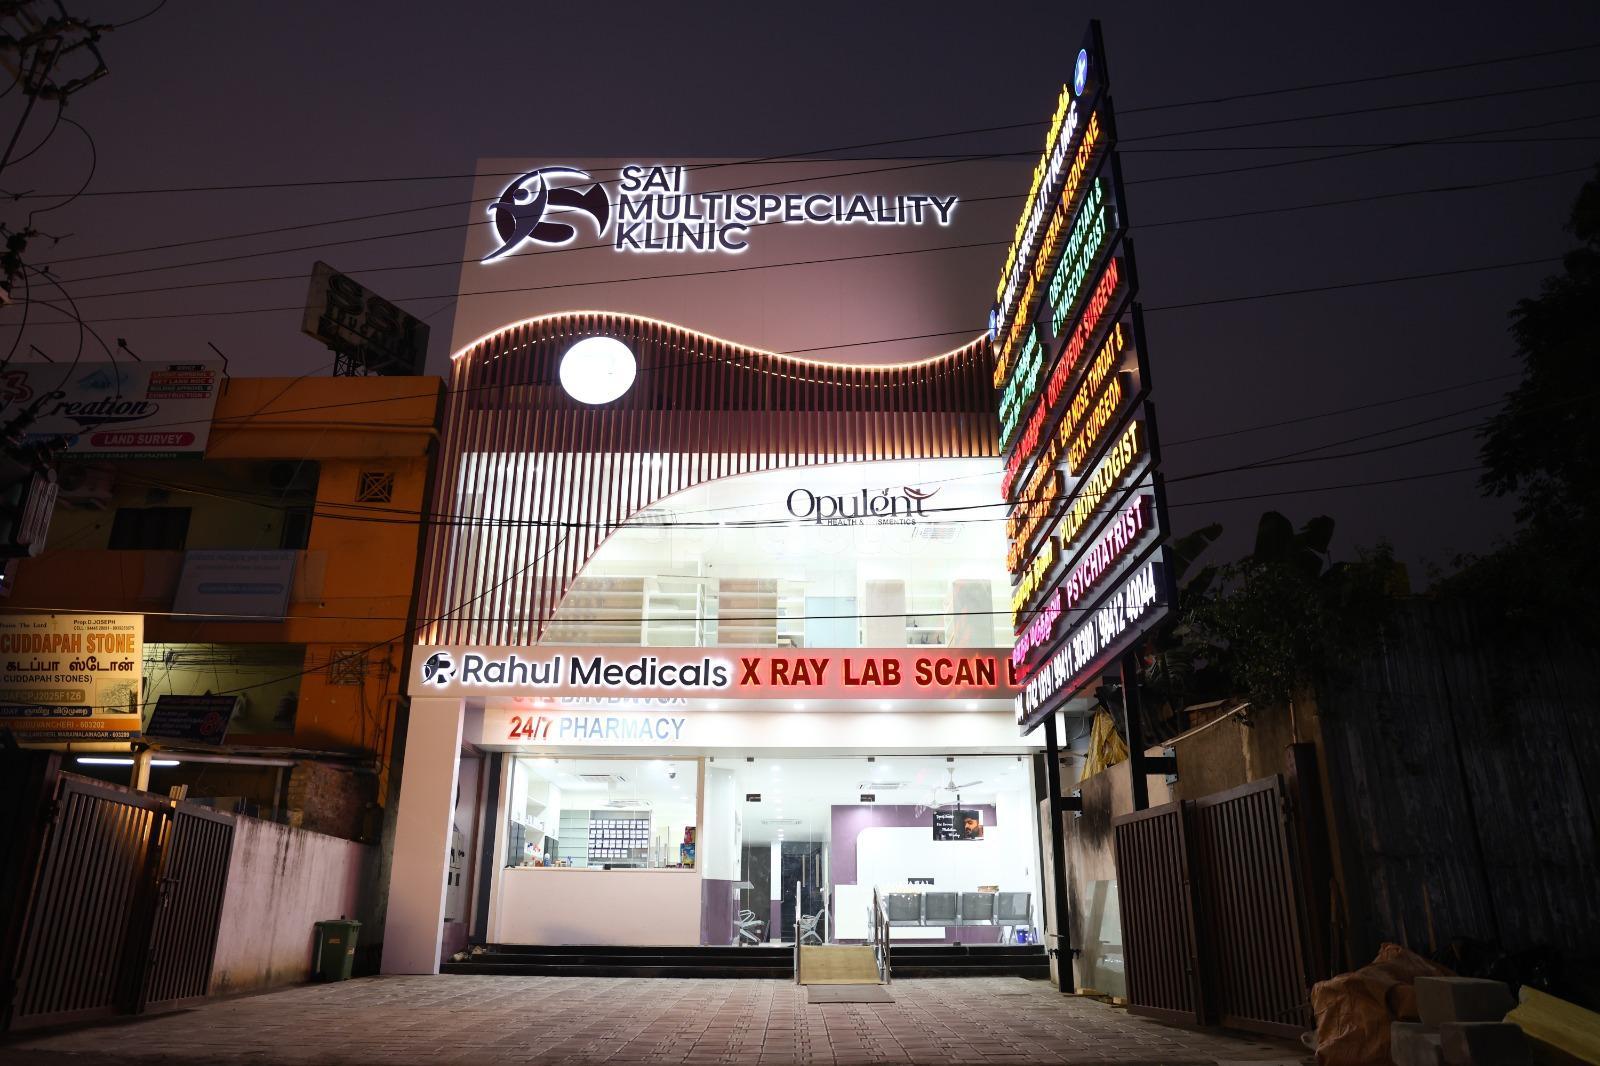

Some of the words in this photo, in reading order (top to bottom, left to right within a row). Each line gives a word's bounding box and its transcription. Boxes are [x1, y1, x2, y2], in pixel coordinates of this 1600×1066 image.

[621, 165, 683, 194] SAI
[1035, 205, 1064, 282] GENERAL
[1062, 110, 1100, 215] MEDICINE
[617, 193, 958, 226] MULTISPECIALITY
[615, 223, 749, 251] KLINIC
[1048, 190, 1095, 309] OBSTETRICIAN
[1052, 205, 1107, 339] GYNAECOLOGIST
[1047, 323, 1085, 409] ORTHOPEDIC
[1084, 257, 1119, 340] SURGEON
[1059, 409, 1073, 448] EAR
[1071, 380, 1090, 428] NOSE
[1087, 331, 1115, 398] THROAT
[1115, 322, 1124, 351] &
[104, 434, 136, 445] LAND
[137, 434, 184, 445] SURVEY
[1067, 428, 1087, 475] NECK
[1085, 376, 1122, 448] SURGEON
[1060, 419, 1138, 549] PULMONOLOGIST
[827, 518, 857, 526] HEALTH
[1066, 494, 1144, 609] PSYCHIATRIST
[1098, 591, 1127, 649] 98412
[0, 633, 82, 654] CUDDAPAH
[86, 633, 135, 654] STONE
[6, 656, 60, 672] கடப்பா
[69, 655, 135, 672] ஸ்டோன்
[54, 674, 93, 684] STONES)
[462, 655, 560, 686] Rahul
[570, 654, 728, 687] Medicals
[739, 657, 761, 685] X
[770, 657, 826, 686] RAY
[842, 657, 901, 686] LAB
[914, 657, 996, 687] SCAN
[80, 721, 105, 730] 603202
[508, 715, 553, 740] 24/7
[559, 716, 687, 740] PHARMACY
